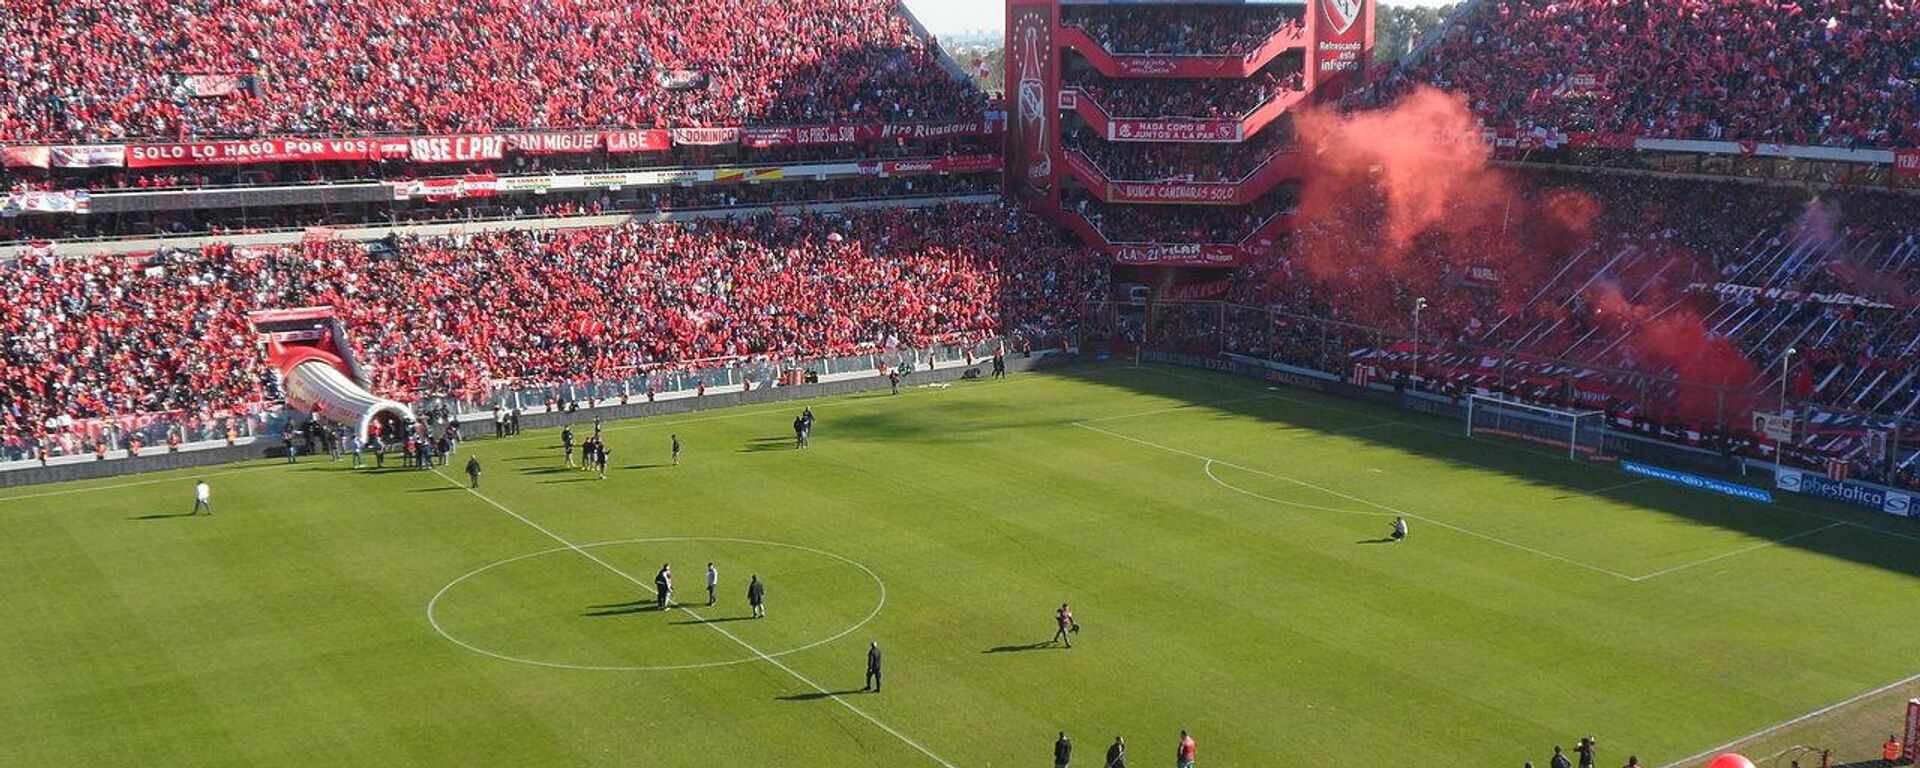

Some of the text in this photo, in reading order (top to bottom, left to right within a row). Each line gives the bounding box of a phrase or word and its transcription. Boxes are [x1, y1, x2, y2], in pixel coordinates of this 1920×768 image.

[1320, 41, 1361, 50] Refrescando
[1339, 51, 1356, 60] este
[1321, 59, 1359, 70] infierno
[914, 122, 978, 138] Rivadavia
[1139, 122, 1164, 131] NADA
[1166, 122, 1194, 132] COMO
[506, 132, 602, 151] SAN MIGUEL
[686, 129, 735, 143] DOMINICO
[1133, 131, 1171, 139] JUNTOS
[1172, 131, 1181, 140] A
[1182, 131, 1195, 140] LA
[133, 146, 184, 159] SOLO
[191, 145, 216, 158] LO
[223, 141, 275, 156] HAGO
[284, 141, 325, 154] POR
[1126, 184, 1156, 198] NUNCA
[1210, 187, 1234, 200] SOLO
[1623, 464, 1768, 502] Allianz Seguros
[1802, 477, 1881, 504] pbestatica
